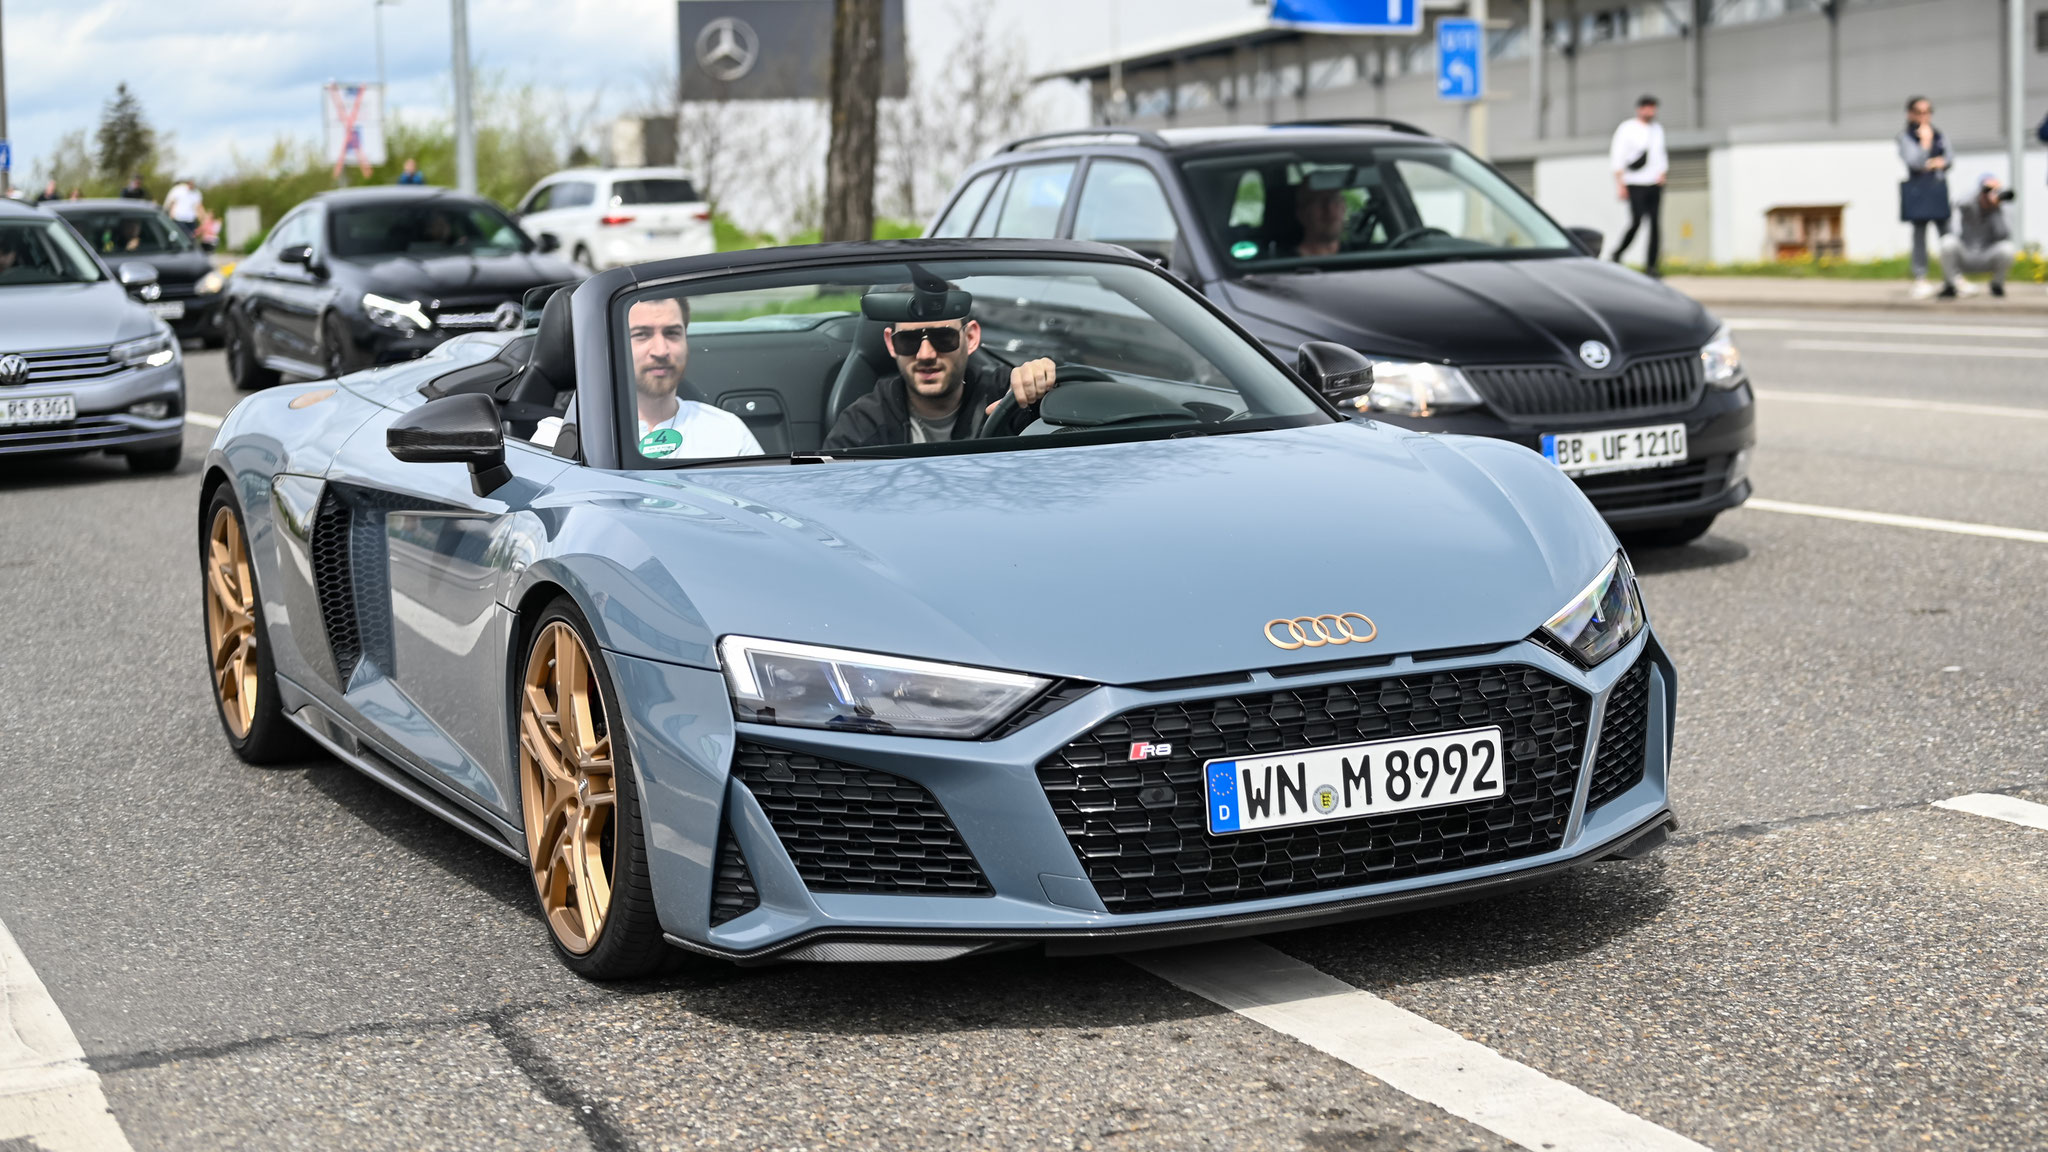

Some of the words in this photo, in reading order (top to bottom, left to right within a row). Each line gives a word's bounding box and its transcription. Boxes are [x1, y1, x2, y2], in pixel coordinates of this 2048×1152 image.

[655, 431, 667, 443] 4
[1557, 439, 1582, 464] BB
[1602, 434, 1627, 460] UF
[1635, 429, 1682, 458] 1210
[1139, 744, 1172, 757] R8
[1219, 805, 1231, 821] D
[1242, 762, 1308, 820] WN
[1341, 755, 1373, 808] M
[1385, 739, 1498, 802] 8992
